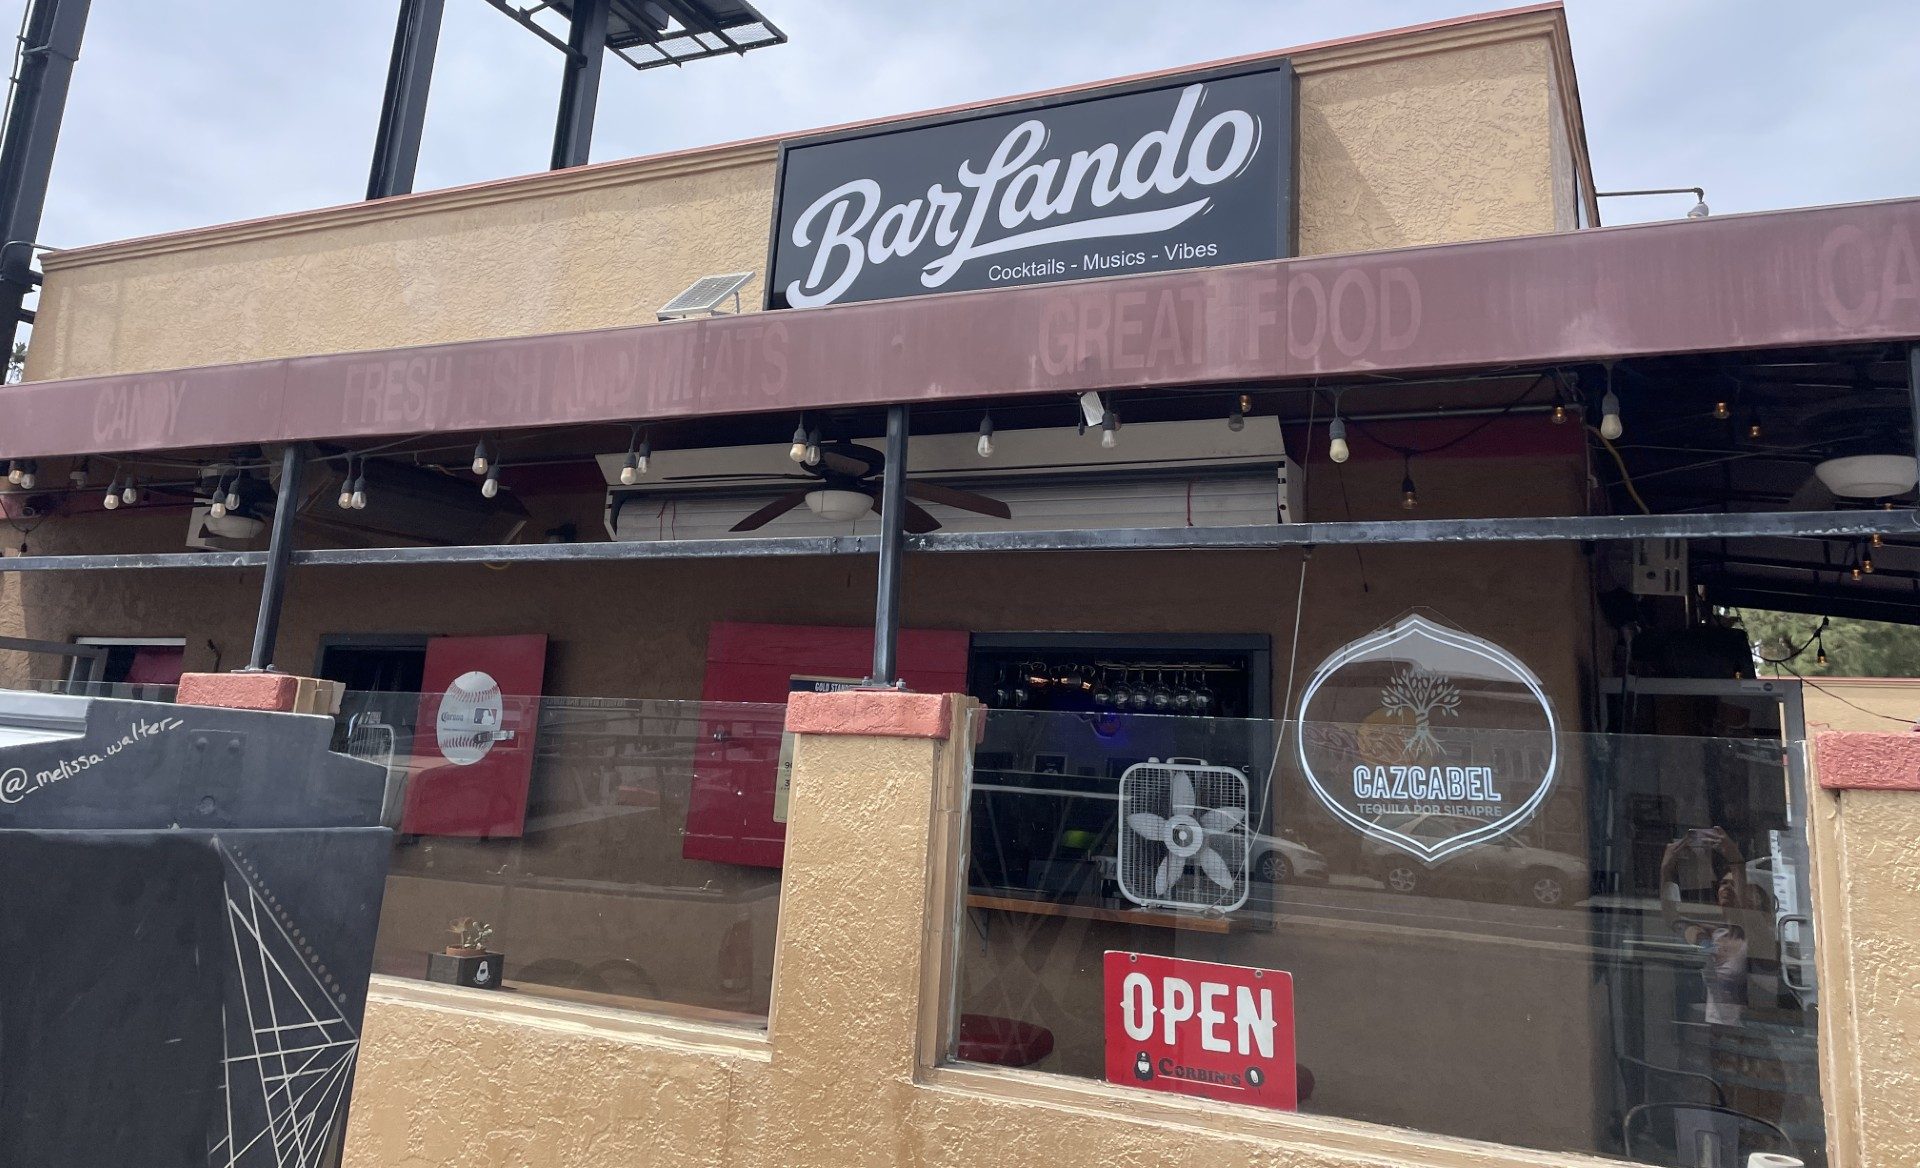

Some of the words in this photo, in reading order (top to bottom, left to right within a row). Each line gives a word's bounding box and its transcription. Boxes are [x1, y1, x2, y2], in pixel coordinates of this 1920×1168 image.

[988, 258, 1066, 282] Cocktails
[1083, 249, 1146, 271] Musics
[1164, 240, 1218, 262] Vibes
[1037, 278, 1216, 377] GREAT
[1246, 266, 1423, 361] FOOD
[341, 356, 453, 426] FRESH
[1352, 765, 1502, 802] CAZCABEL
[1356, 803, 1412, 816] TEQUILA
[1413, 803, 1442, 816] POR
[1443, 804, 1503, 818] SIEMPRE
[1119, 972, 1278, 1059] OPEN
